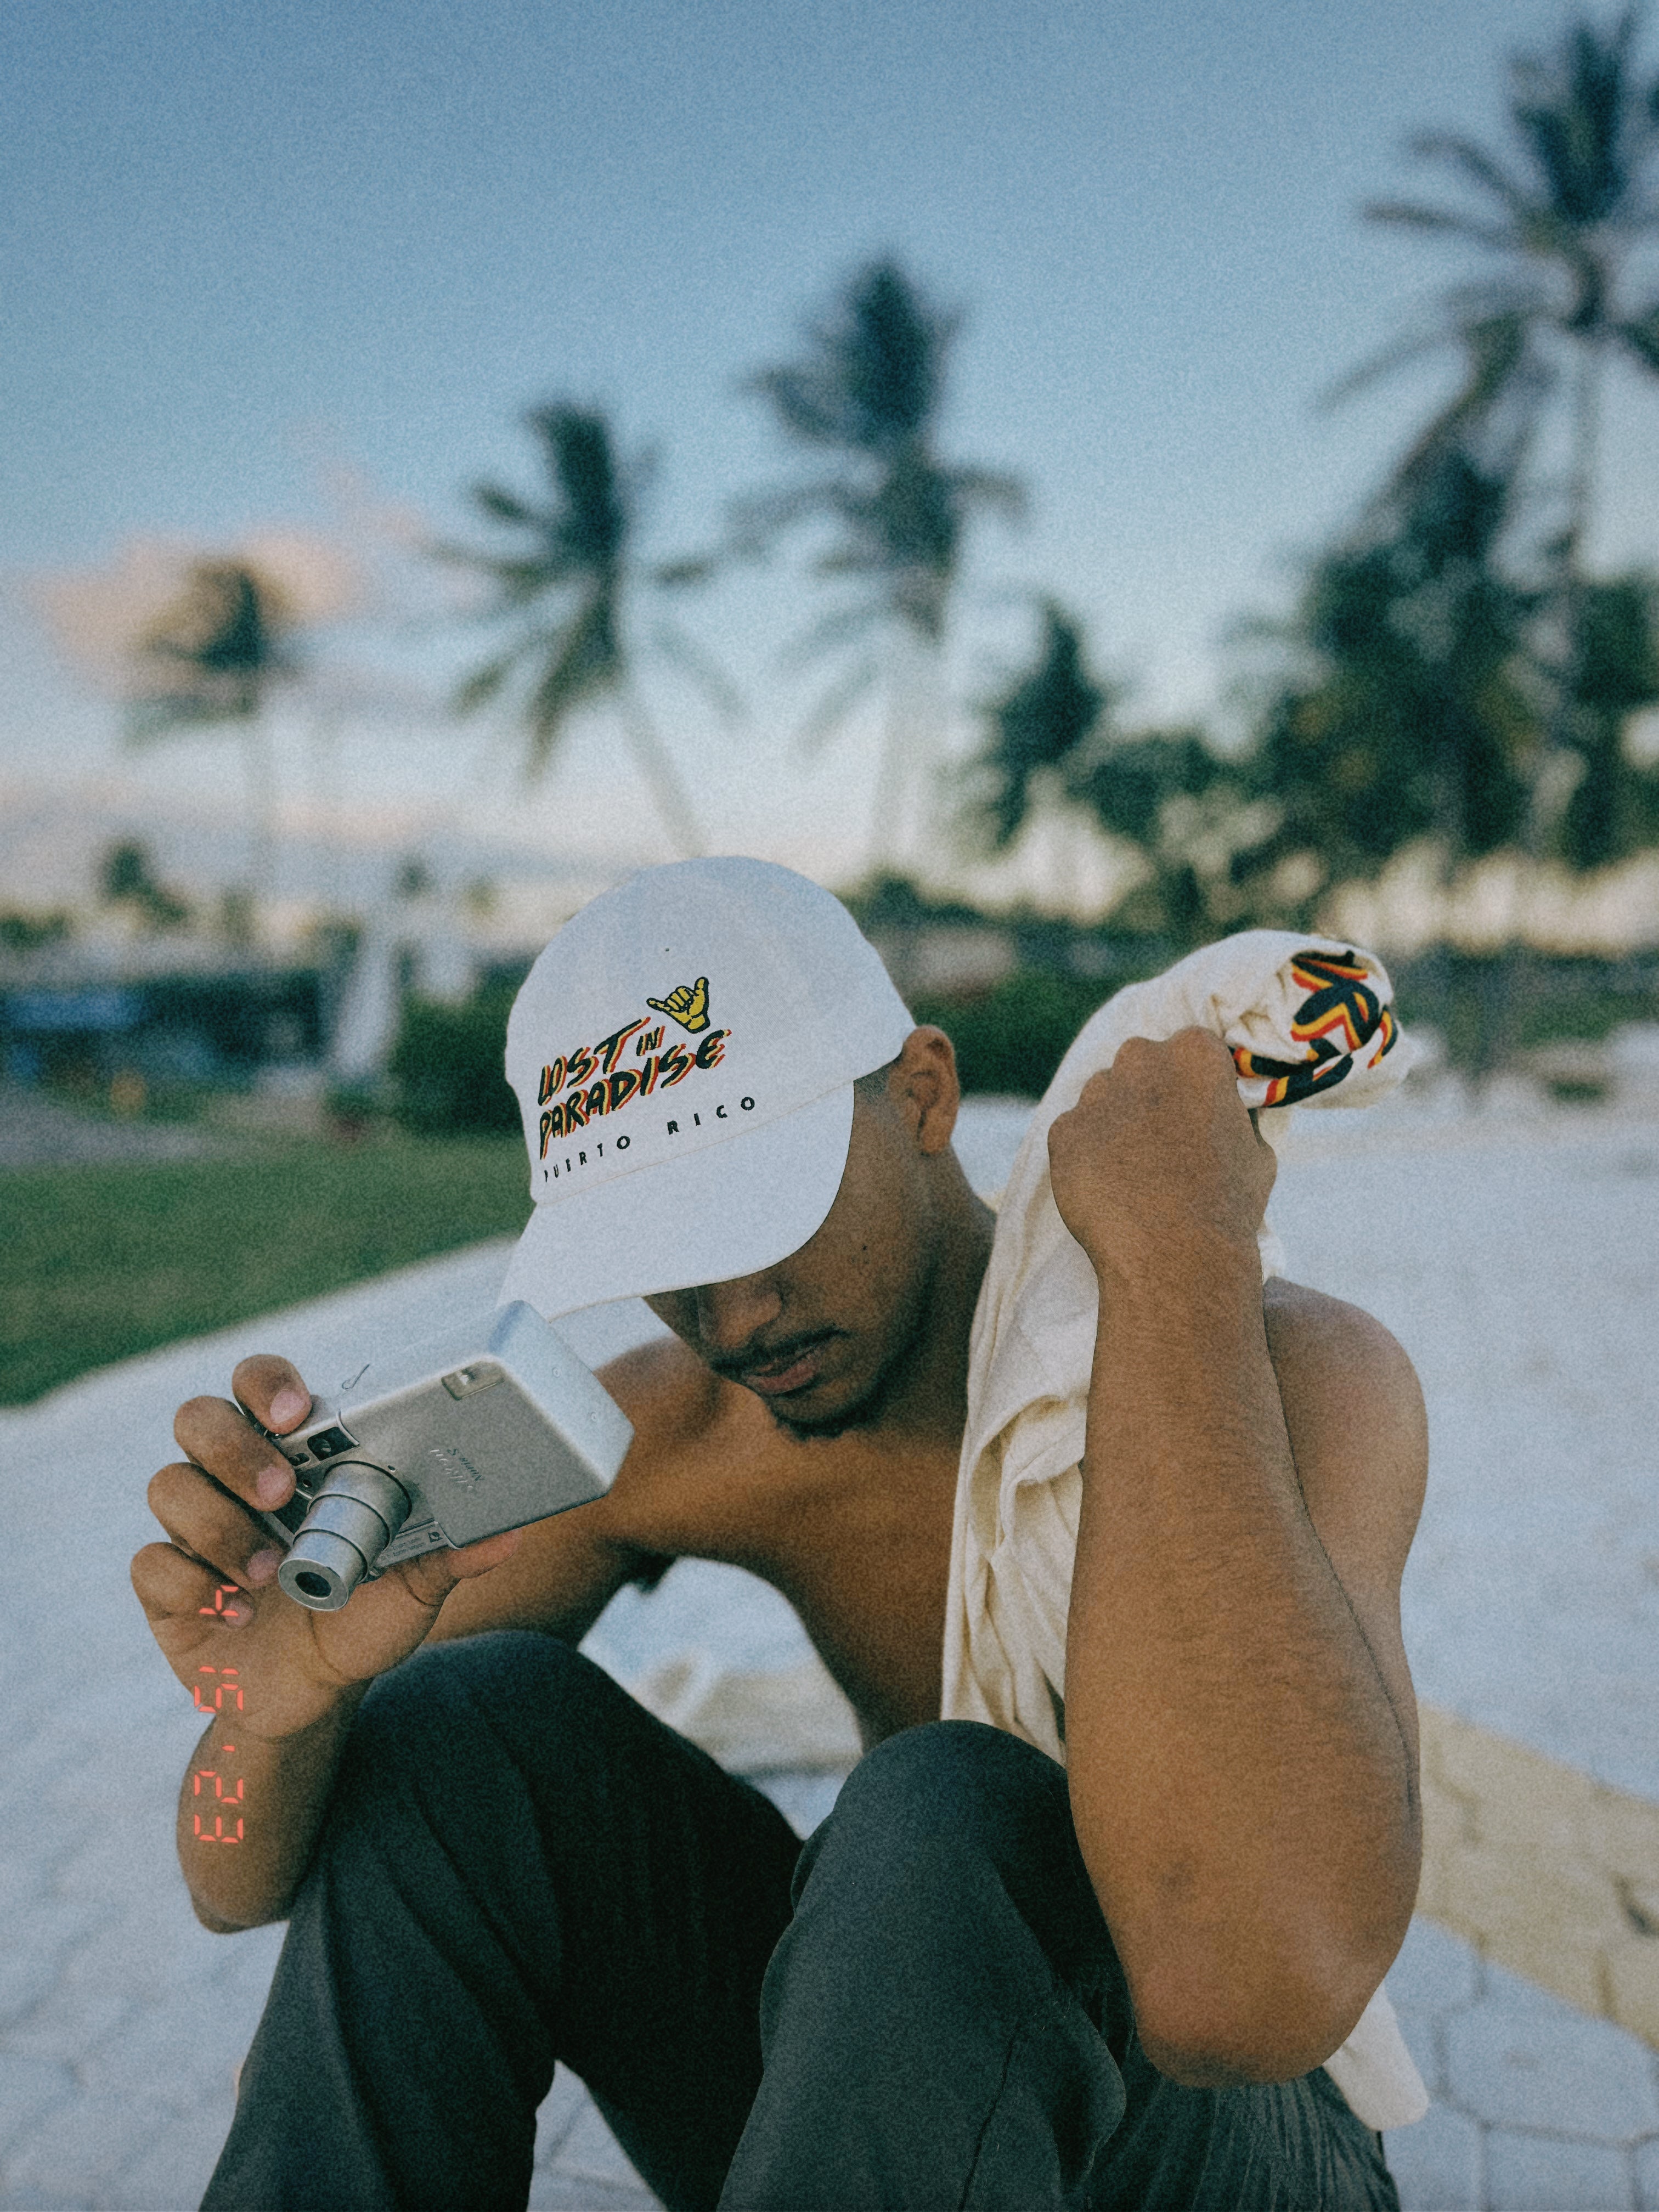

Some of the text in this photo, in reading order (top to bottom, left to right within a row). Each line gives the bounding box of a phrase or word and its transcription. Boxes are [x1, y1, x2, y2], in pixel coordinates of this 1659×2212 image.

[538, 1016, 665, 1106] LOST IN
[539, 1029, 732, 1160] PARADISE
[544, 1096, 755, 1183] PUERTO RICO
